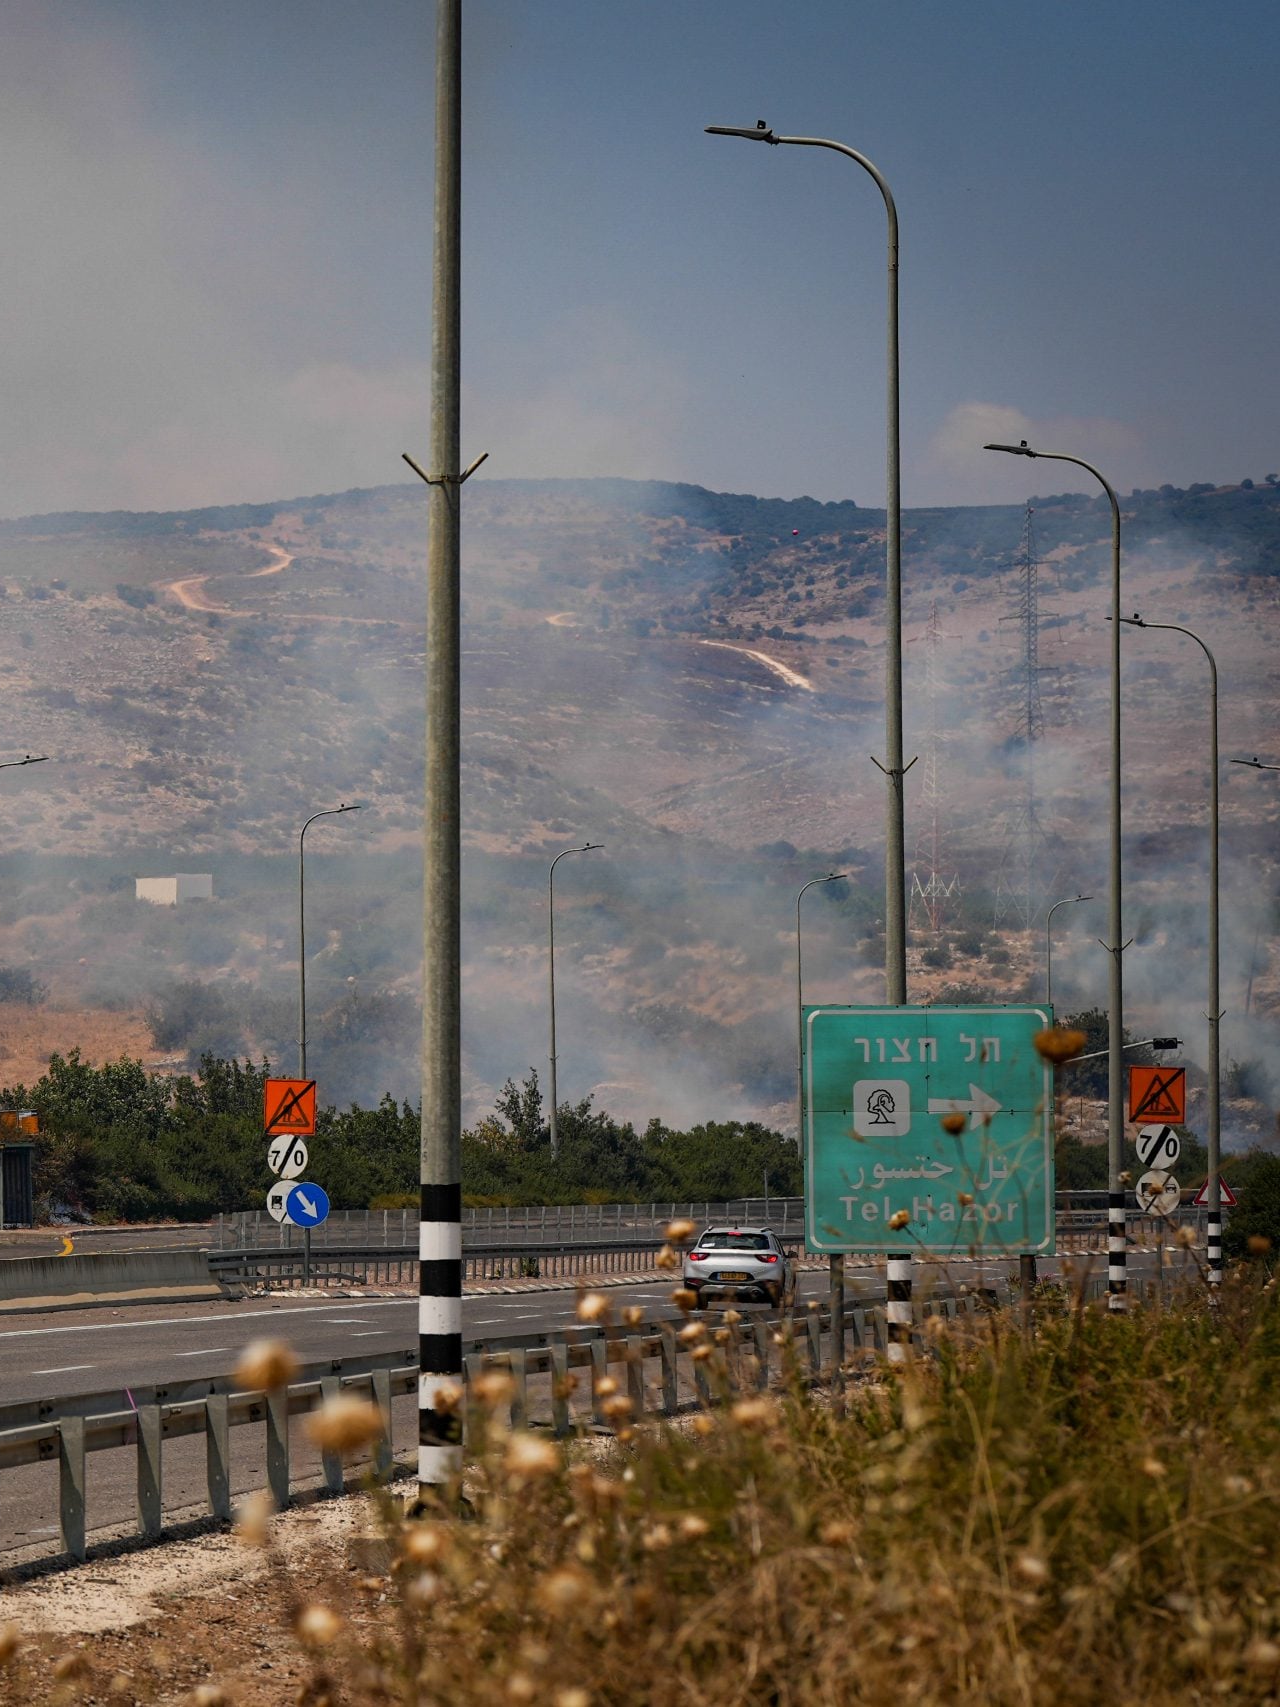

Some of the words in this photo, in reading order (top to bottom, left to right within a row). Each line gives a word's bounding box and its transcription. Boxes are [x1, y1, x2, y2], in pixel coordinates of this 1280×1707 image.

[853, 1037, 938, 1063] חצור
[959, 1033, 1001, 1063] תל
[839, 1195, 891, 1222] Tel
[912, 1196, 1019, 1223] Hazor
